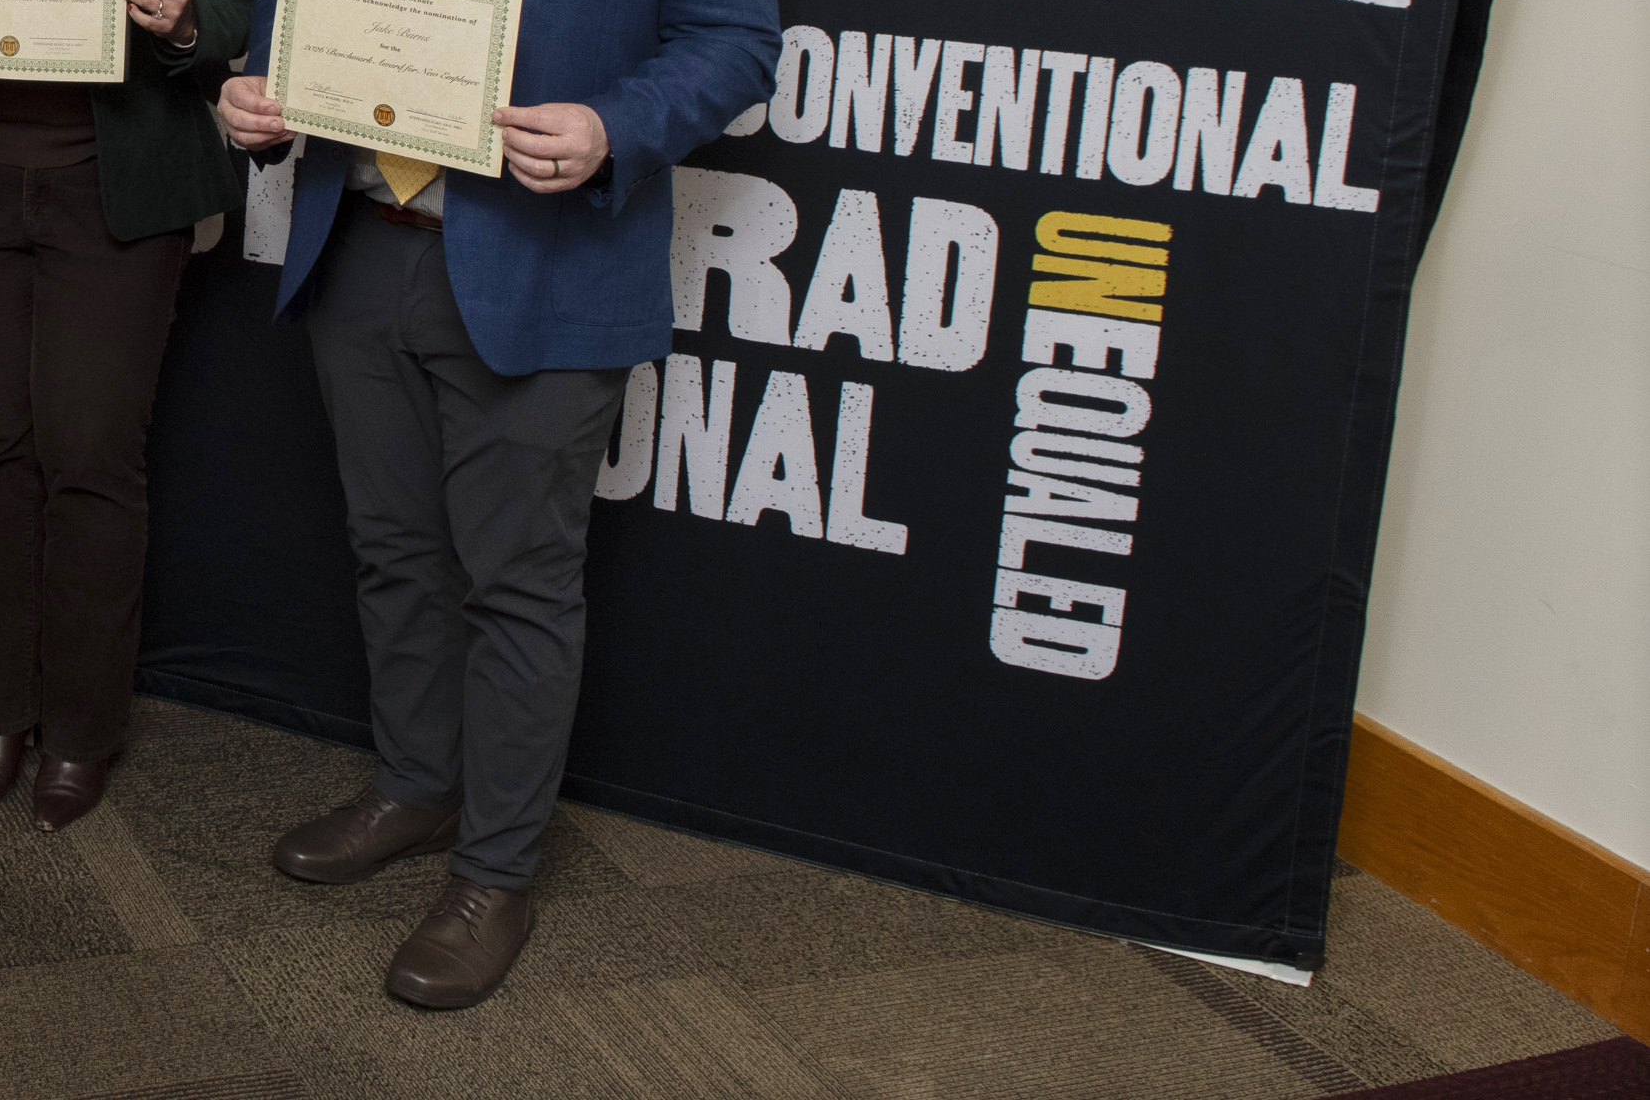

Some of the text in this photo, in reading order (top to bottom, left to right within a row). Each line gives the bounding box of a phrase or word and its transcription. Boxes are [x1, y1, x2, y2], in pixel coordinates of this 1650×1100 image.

[409, 6, 422, 14] the
[423, 9, 467, 23] nomination
[468, 18, 478, 26] of
[364, 21, 431, 43] Jake Burns
[379, 42, 401, 53] for the
[324, 46, 373, 64] Benchmark
[440, 71, 480, 87] Employee
[722, 24, 1380, 213] ONVENTIONAL
[989, 210, 1173, 680] UNEQUALED
